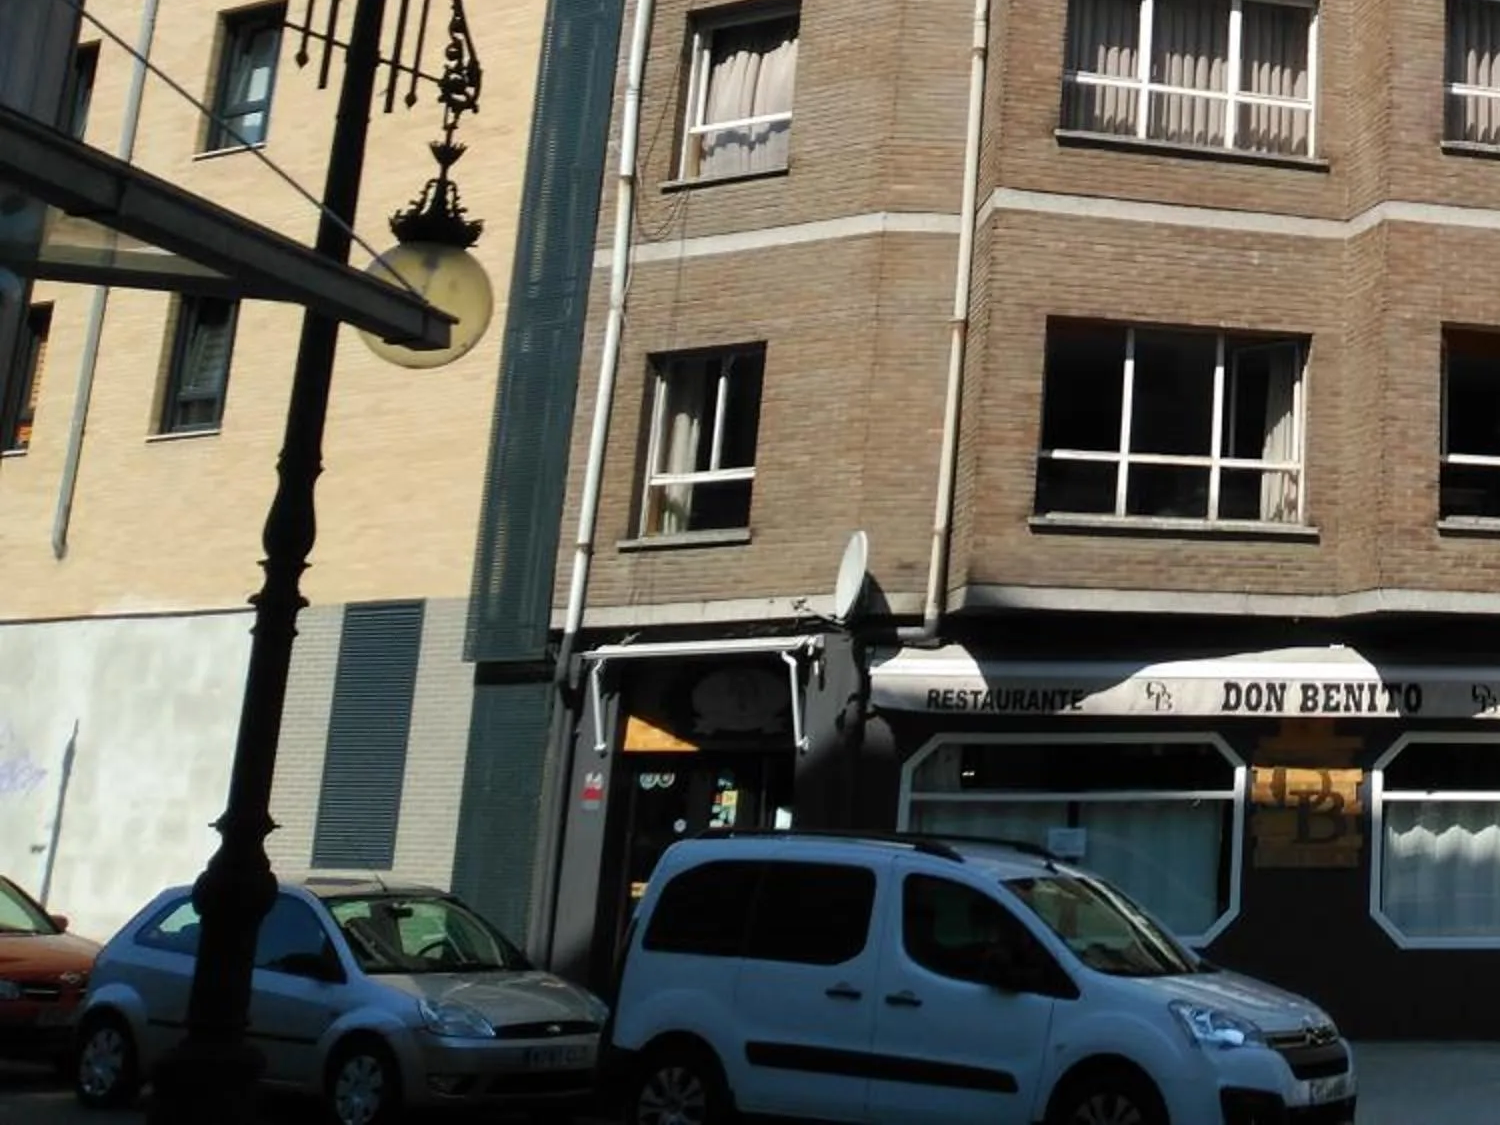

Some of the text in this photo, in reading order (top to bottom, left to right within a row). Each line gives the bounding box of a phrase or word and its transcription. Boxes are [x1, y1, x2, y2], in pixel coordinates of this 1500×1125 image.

[927, 688, 1083, 711] RESTAURANTE
[1221, 681, 1422, 713] DON BENITO
